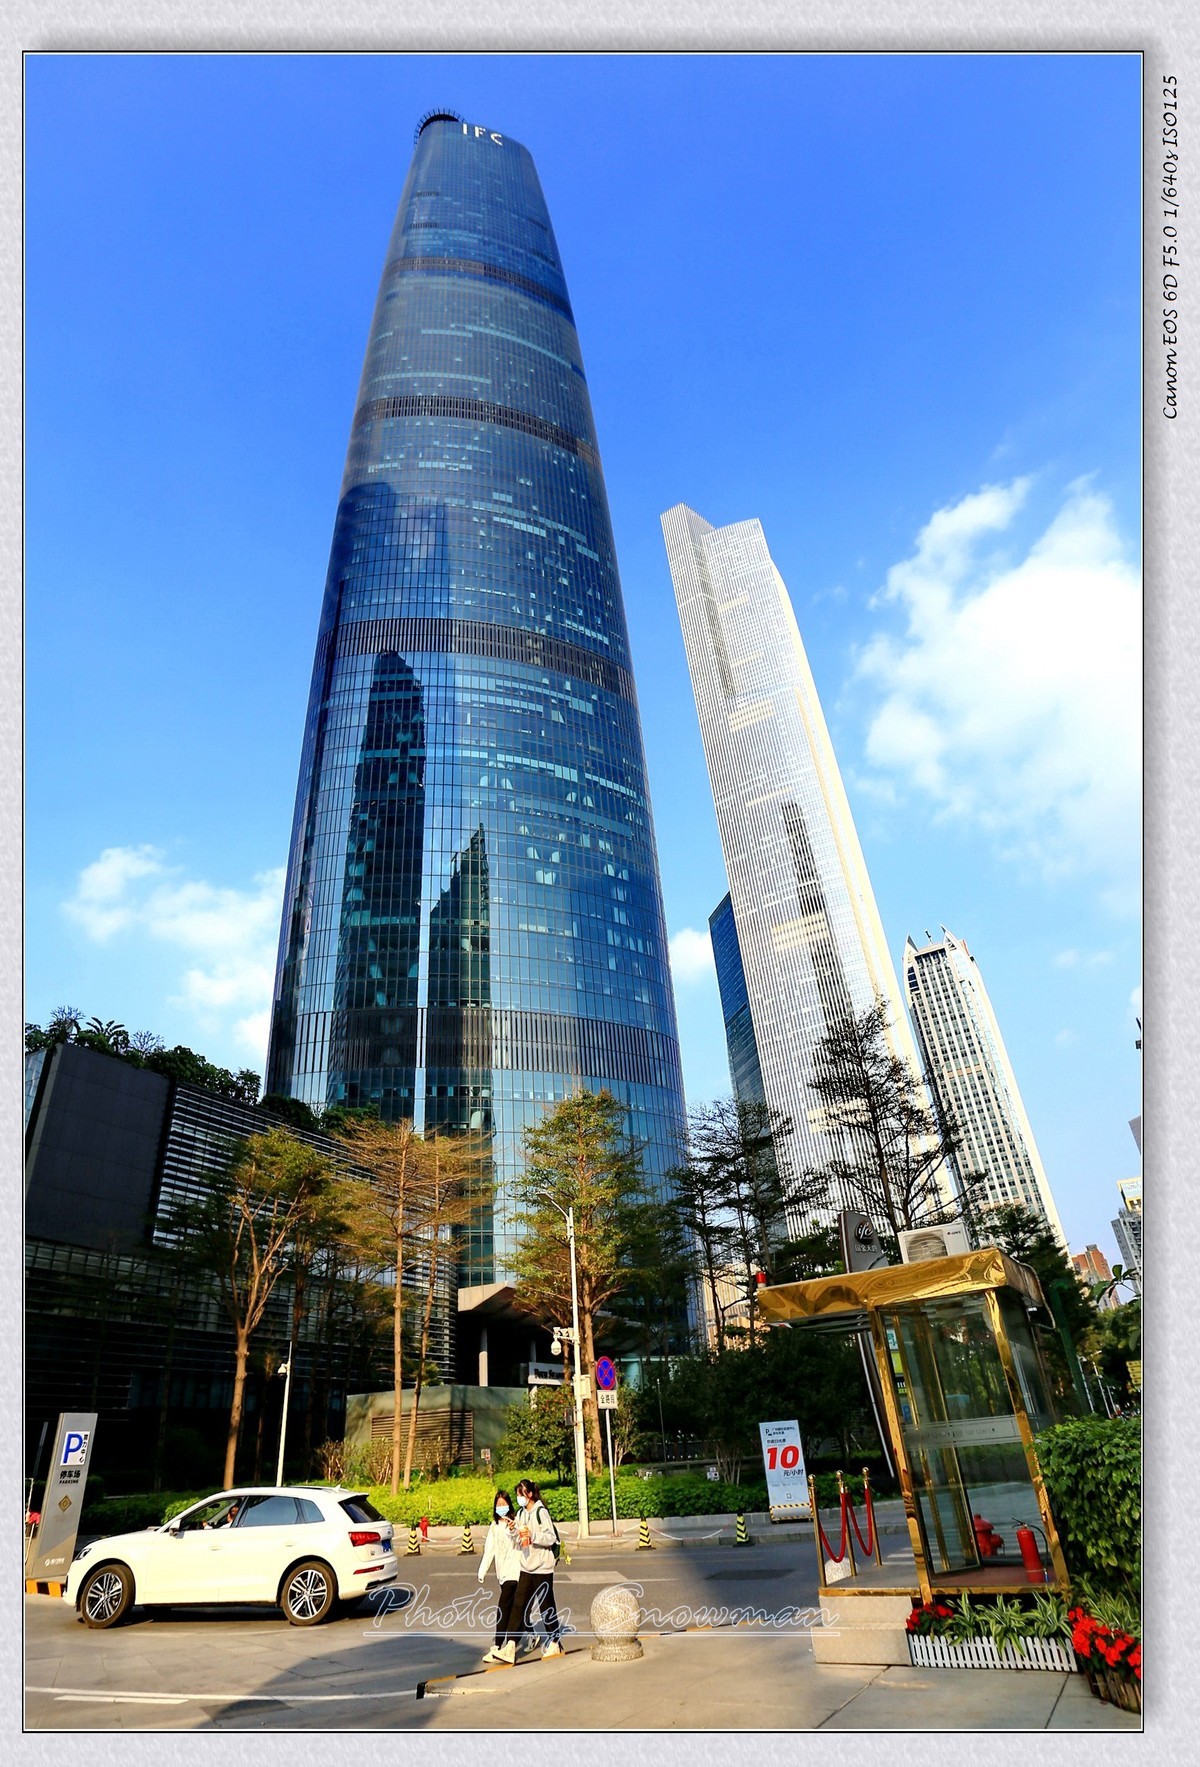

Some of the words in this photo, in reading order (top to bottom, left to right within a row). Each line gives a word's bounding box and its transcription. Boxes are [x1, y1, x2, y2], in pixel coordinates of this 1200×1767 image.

[462, 123, 503, 146] IFC
[63, 1433, 83, 1464] P
[767, 1446, 800, 1470] 10
[59, 1470, 81, 1479] 停车场
